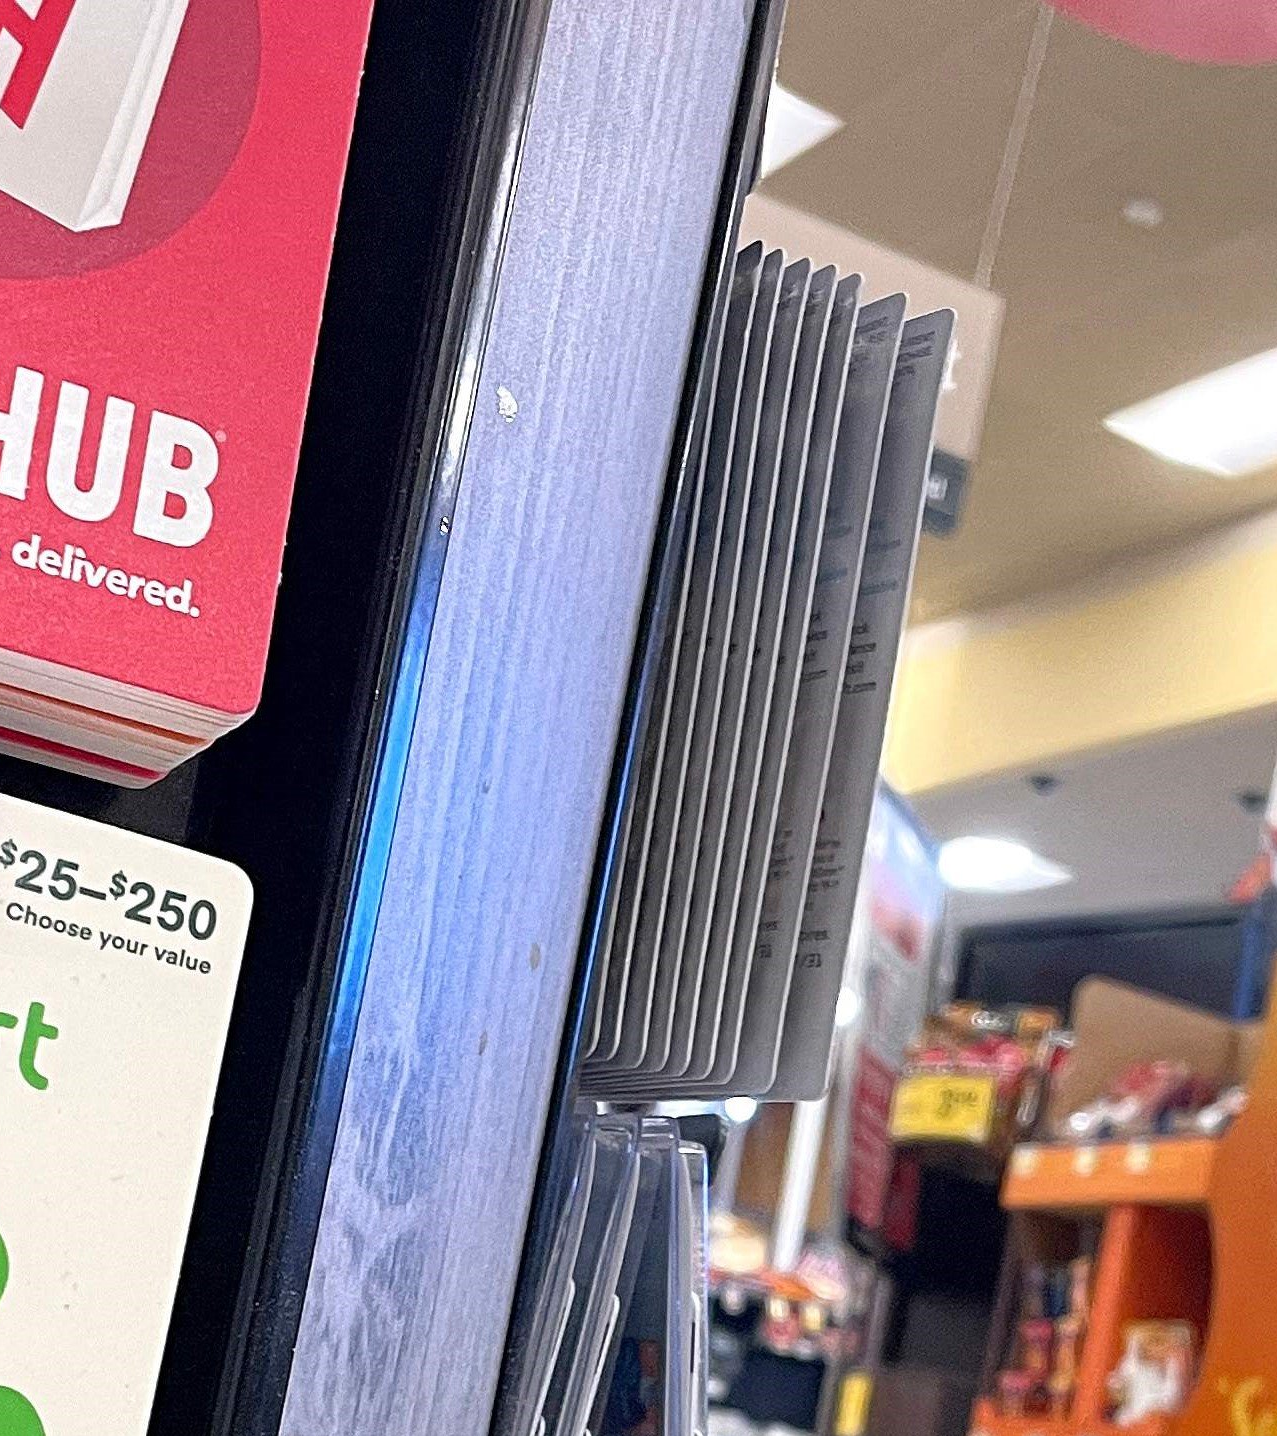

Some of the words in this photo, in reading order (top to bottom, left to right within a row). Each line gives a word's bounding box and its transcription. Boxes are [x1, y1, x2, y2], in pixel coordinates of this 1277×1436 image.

[10, 533, 202, 620] delivered.
[4, 901, 93, 943] Choose
[99, 926, 150, 959] your
[153, 941, 213, 976] value
